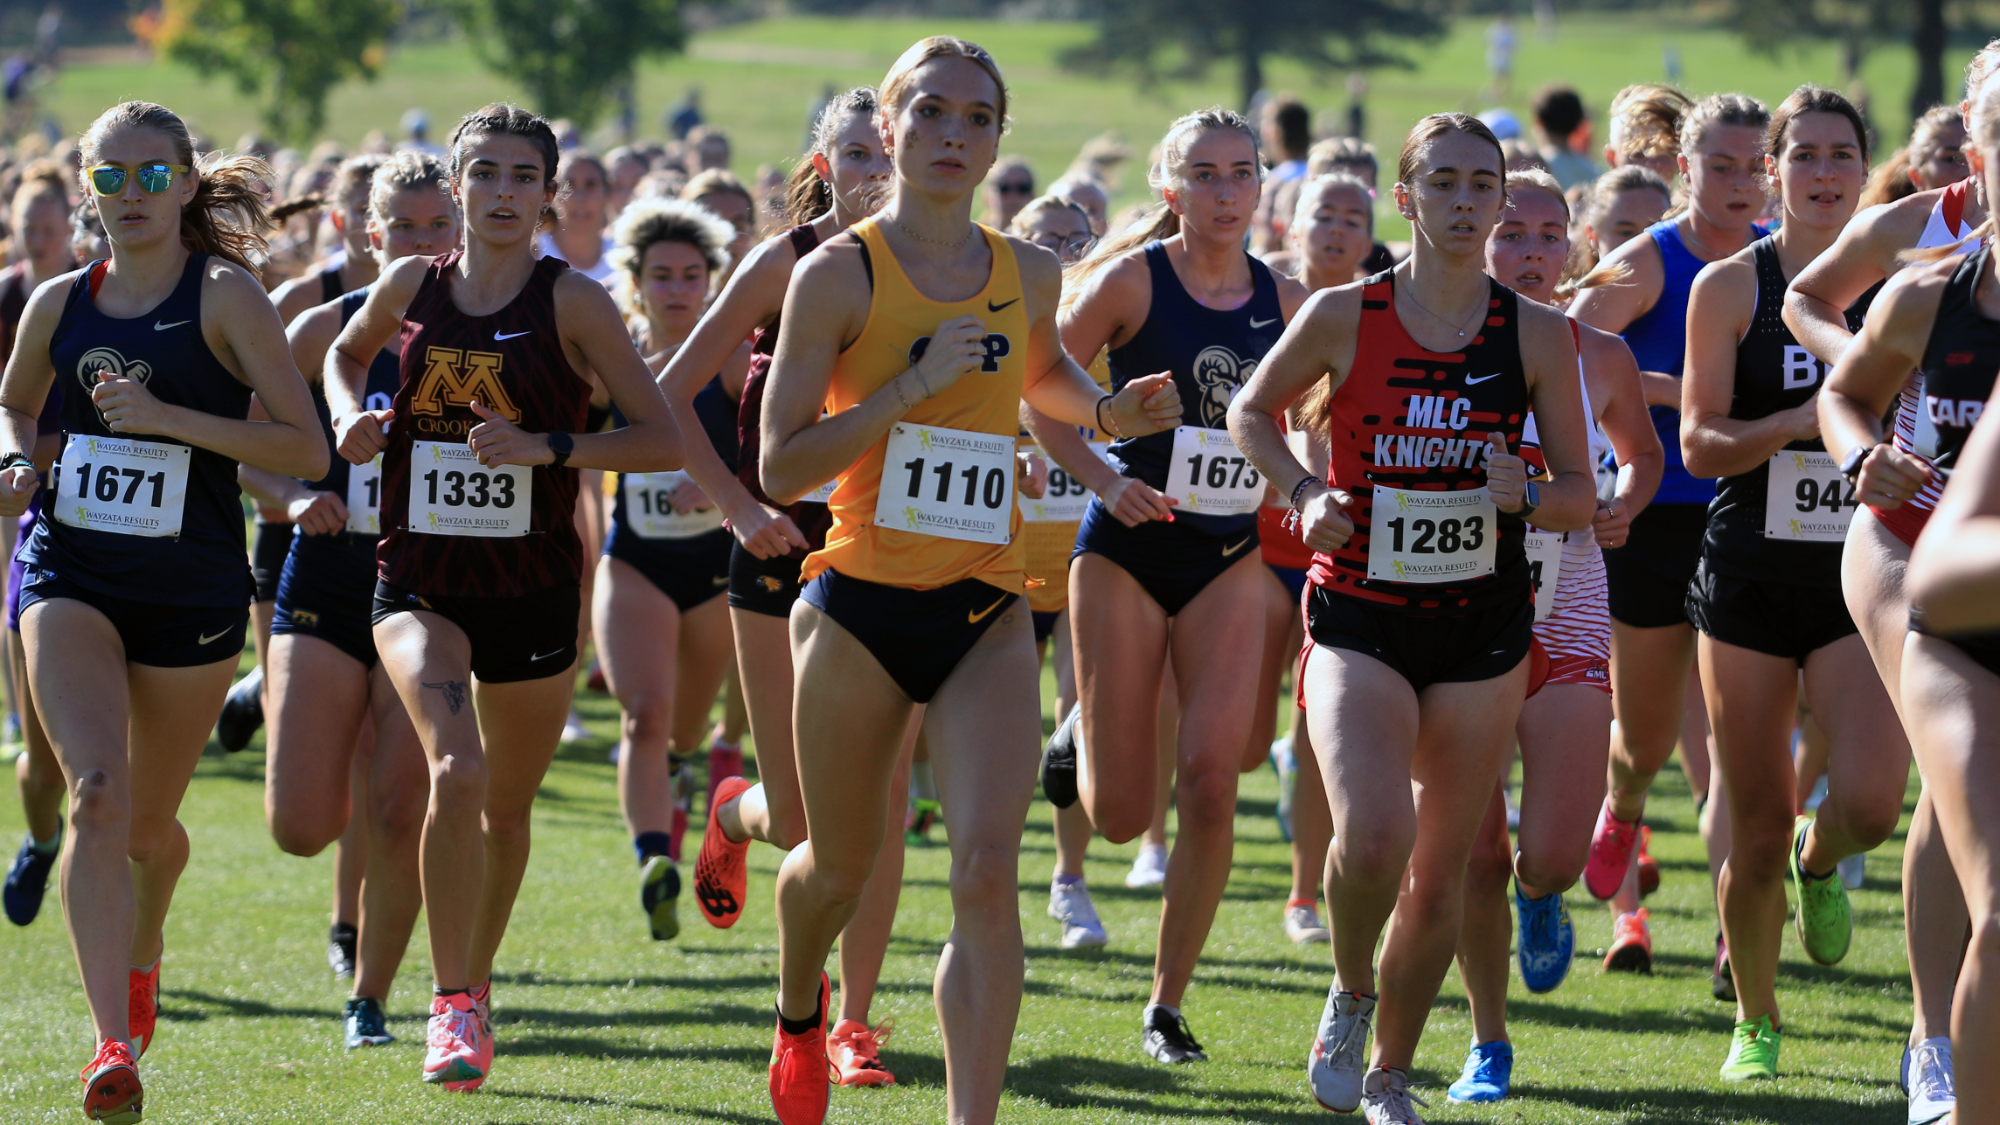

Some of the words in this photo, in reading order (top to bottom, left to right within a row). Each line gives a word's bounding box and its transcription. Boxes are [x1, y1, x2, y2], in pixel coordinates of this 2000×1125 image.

[1405, 394, 1472, 431] MLC
[96, 442, 133, 454] WAYZATA
[133, 446, 169, 458] RESULTS
[930, 434, 972, 448] WAYZATA
[973, 440, 1005, 452] RESULTS
[1374, 434, 1494, 471] KNIGHTS
[1187, 453, 1260, 489] 1673
[76, 462, 166, 508] 1671
[424, 469, 515, 509] 1333
[904, 457, 1005, 509] 1110
[1197, 497, 1228, 505] WAYZATA
[1406, 496, 1446, 506] WAYZATA
[1448, 494, 1482, 504] RESULTS
[1795, 478, 1857, 513] 944
[86, 511, 122, 523] WAYZATA
[124, 516, 160, 527] RESULTS
[437, 516, 473, 526] WAYZATA
[475, 518, 510, 527] RESULTS
[916, 512, 959, 526] WAYZATA
[961, 519, 996, 531] RESULTS
[1800, 522, 1836, 531] WAYZATA
[1387, 515, 1484, 554] 1283
[1404, 564, 1443, 573] WAYZATA
[1445, 560, 1478, 572] RESULTS
